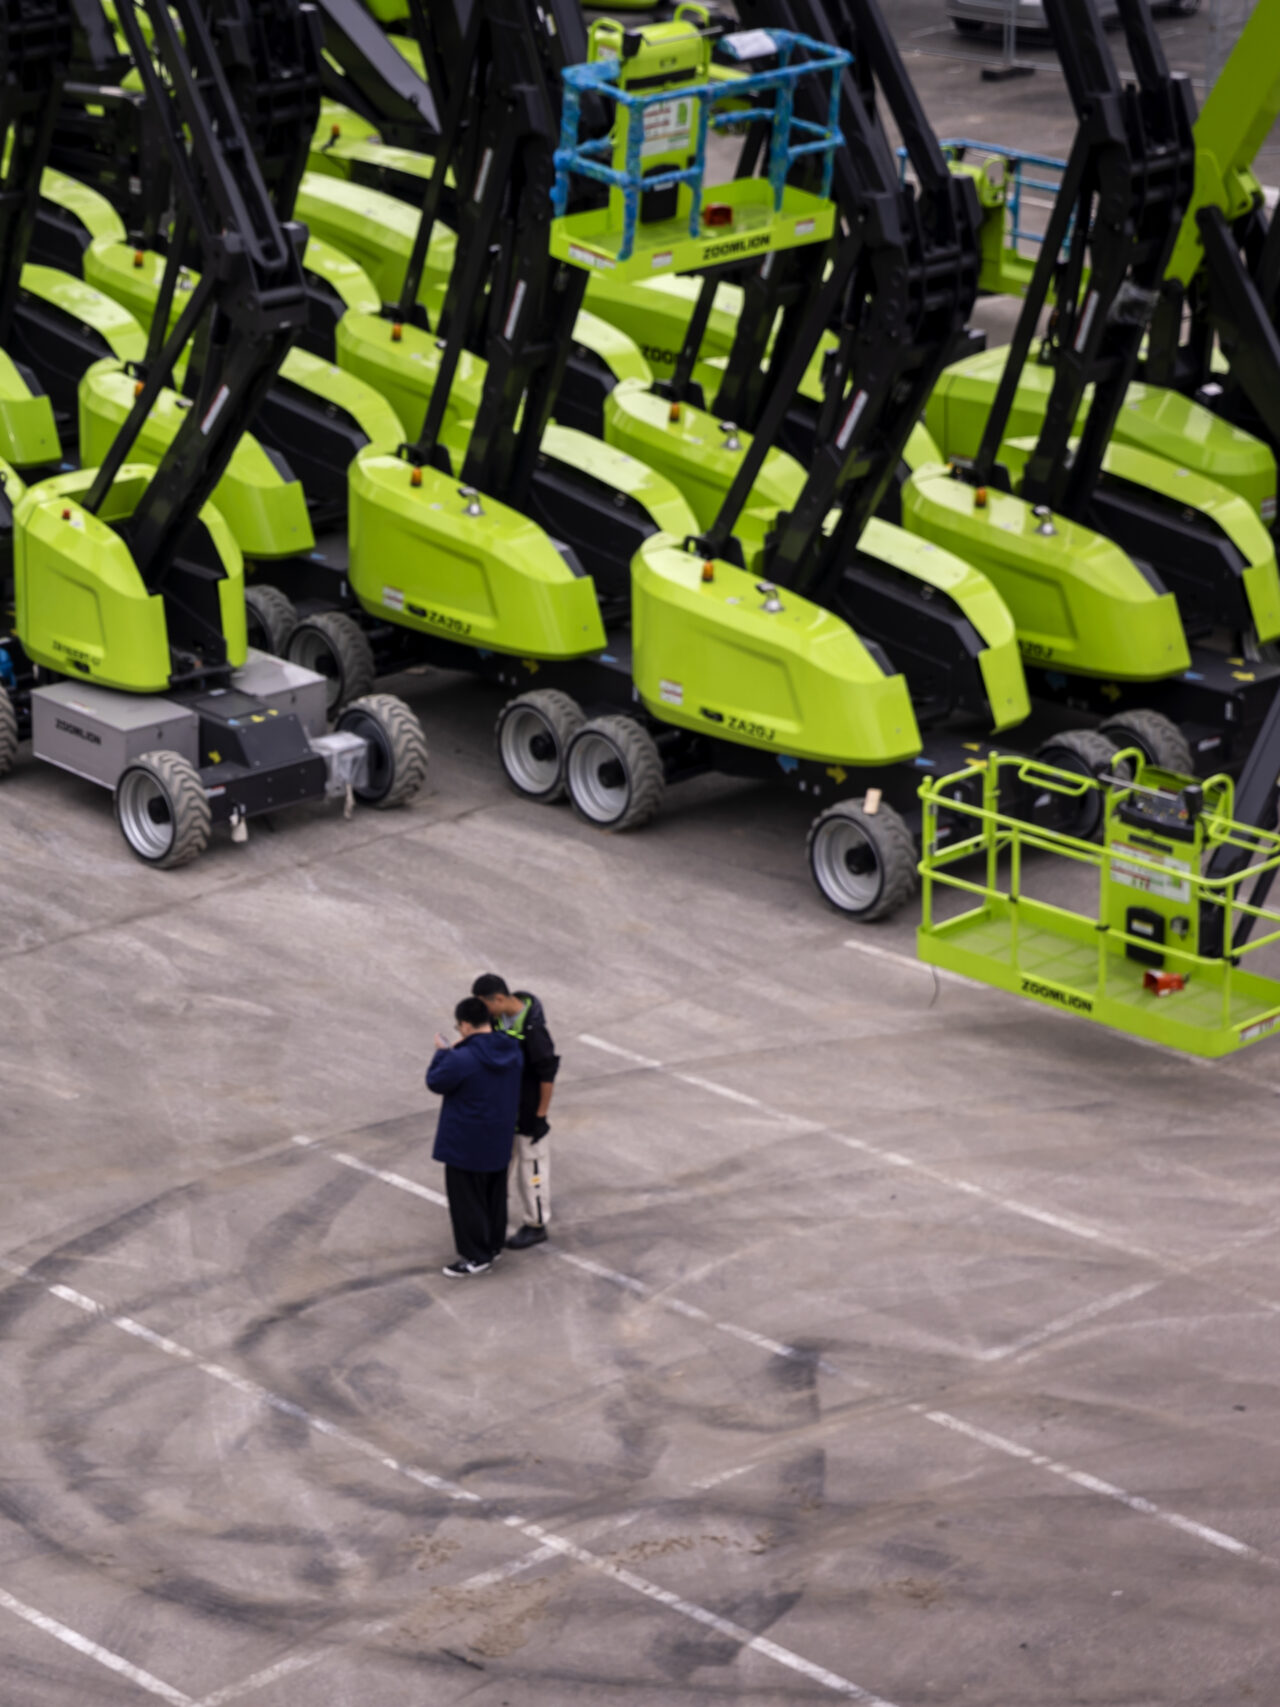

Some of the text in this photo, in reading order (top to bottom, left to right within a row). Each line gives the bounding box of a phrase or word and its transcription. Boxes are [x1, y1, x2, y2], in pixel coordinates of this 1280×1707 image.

[703, 233, 771, 261] ZOOMLION
[640, 343, 678, 366] ZOO
[728, 716, 776, 741] ZA20J
[1021, 978, 1094, 1013] ZOOMLION
